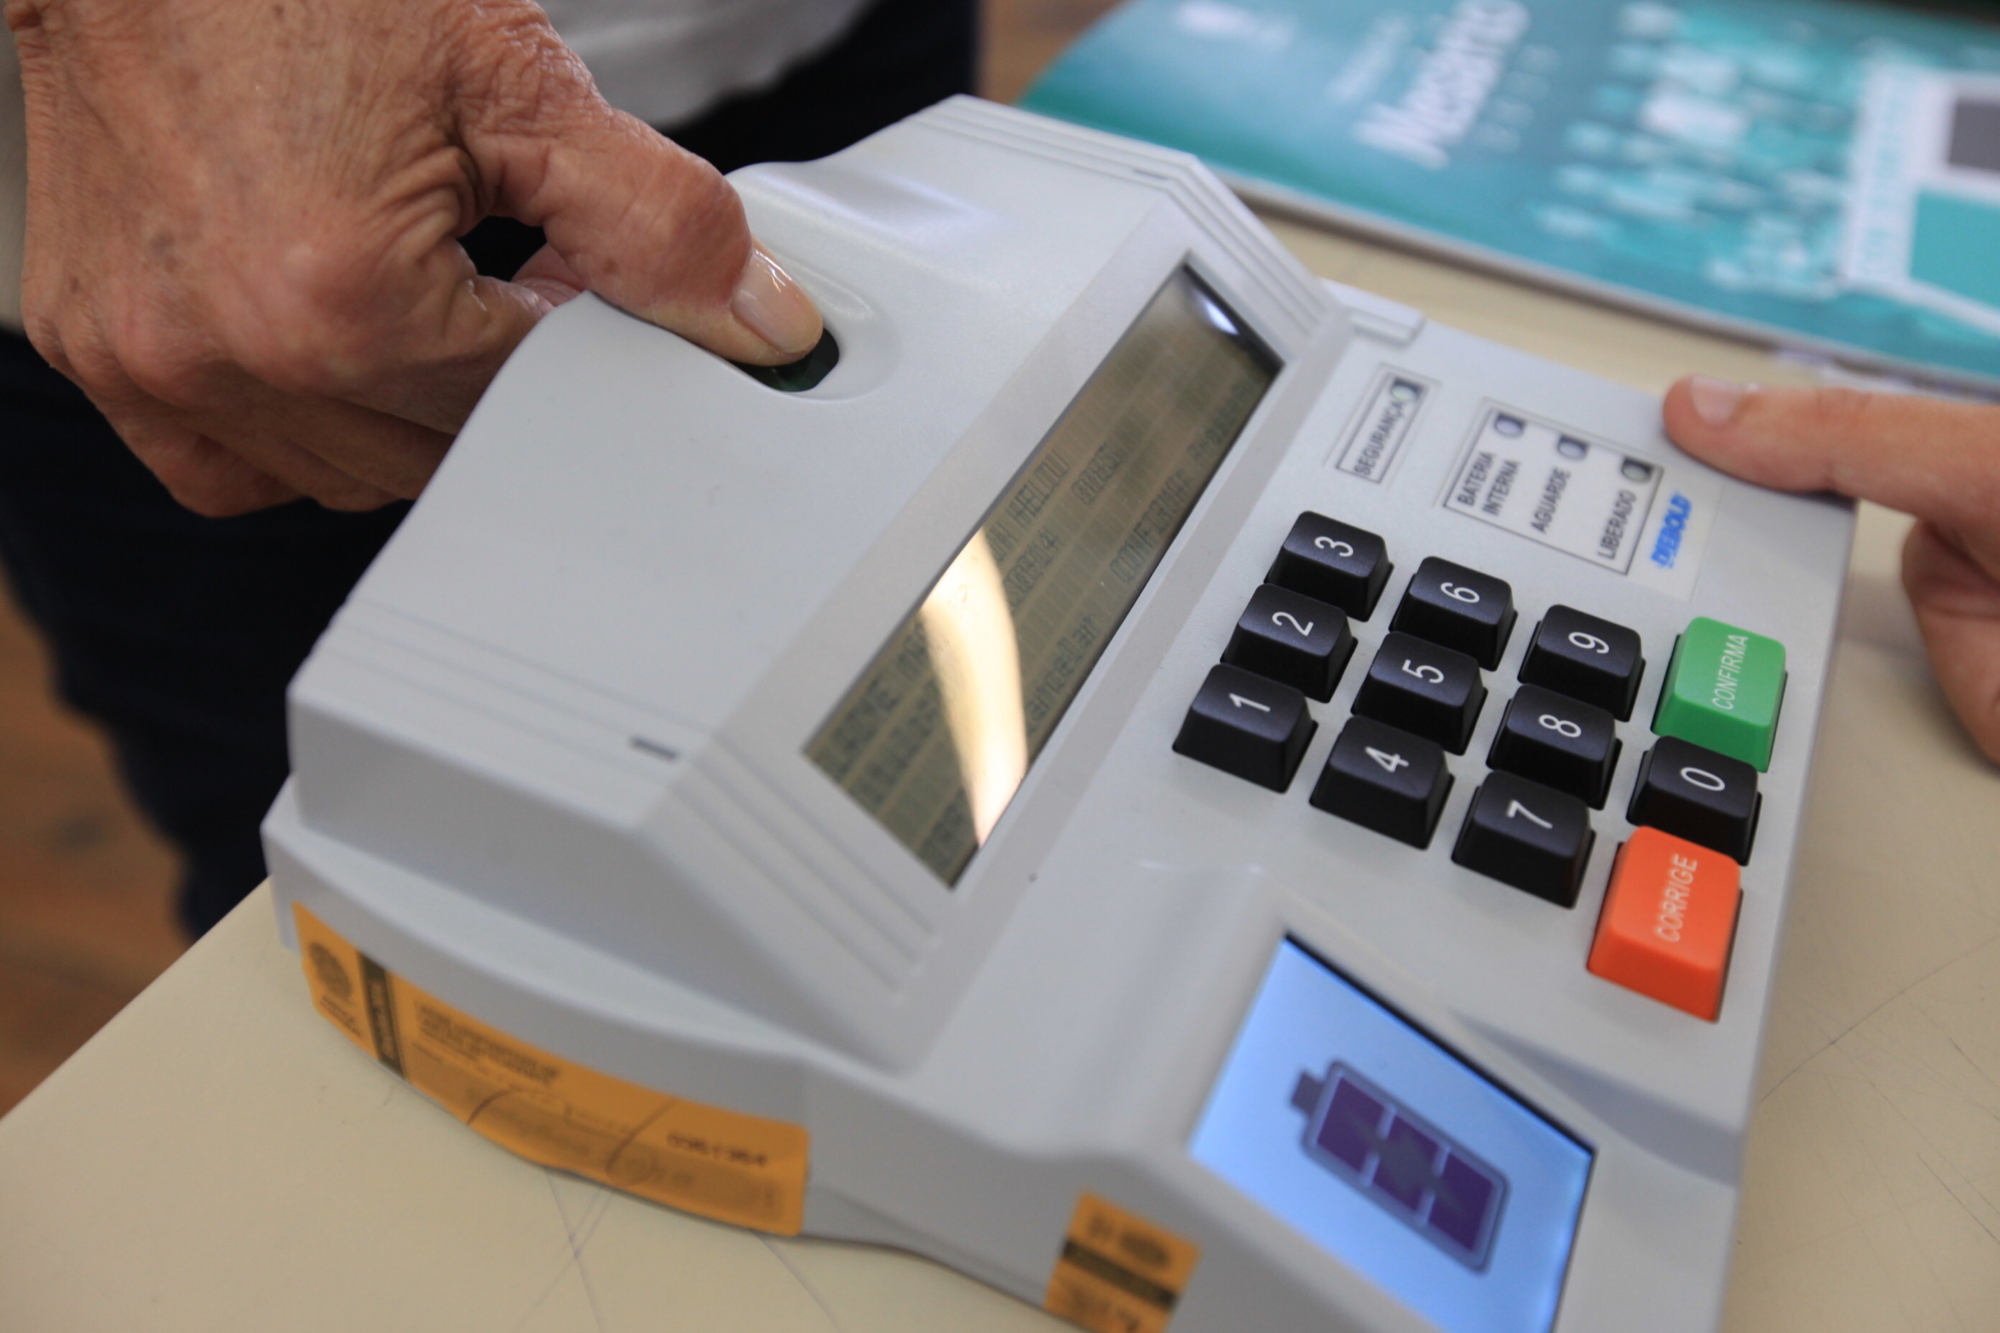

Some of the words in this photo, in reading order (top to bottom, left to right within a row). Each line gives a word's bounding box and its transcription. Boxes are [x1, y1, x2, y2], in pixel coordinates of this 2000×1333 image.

[1353, 400, 1408, 477] SEGURANÇA
[1457, 451, 1495, 506] BATERIA
[1483, 460, 1521, 515] INTERNA
[1530, 468, 1571, 533] AGUARDE
[1598, 490, 1637, 560] LIBERADO
[1314, 536, 1354, 557] 3
[1440, 582, 1480, 604] 6
[1271, 611, 1314, 637] 2
[1568, 631, 1610, 655] 9
[1402, 659, 1444, 684] 5
[1711, 633, 1749, 711] CONFIRMA
[1228, 692, 1271, 712] 1
[1538, 713, 1582, 738] 8
[1365, 746, 1409, 773] 4
[1680, 766, 1726, 791] 0
[1506, 800, 1553, 829] 7
[1653, 853, 1699, 942] CORRIGE
